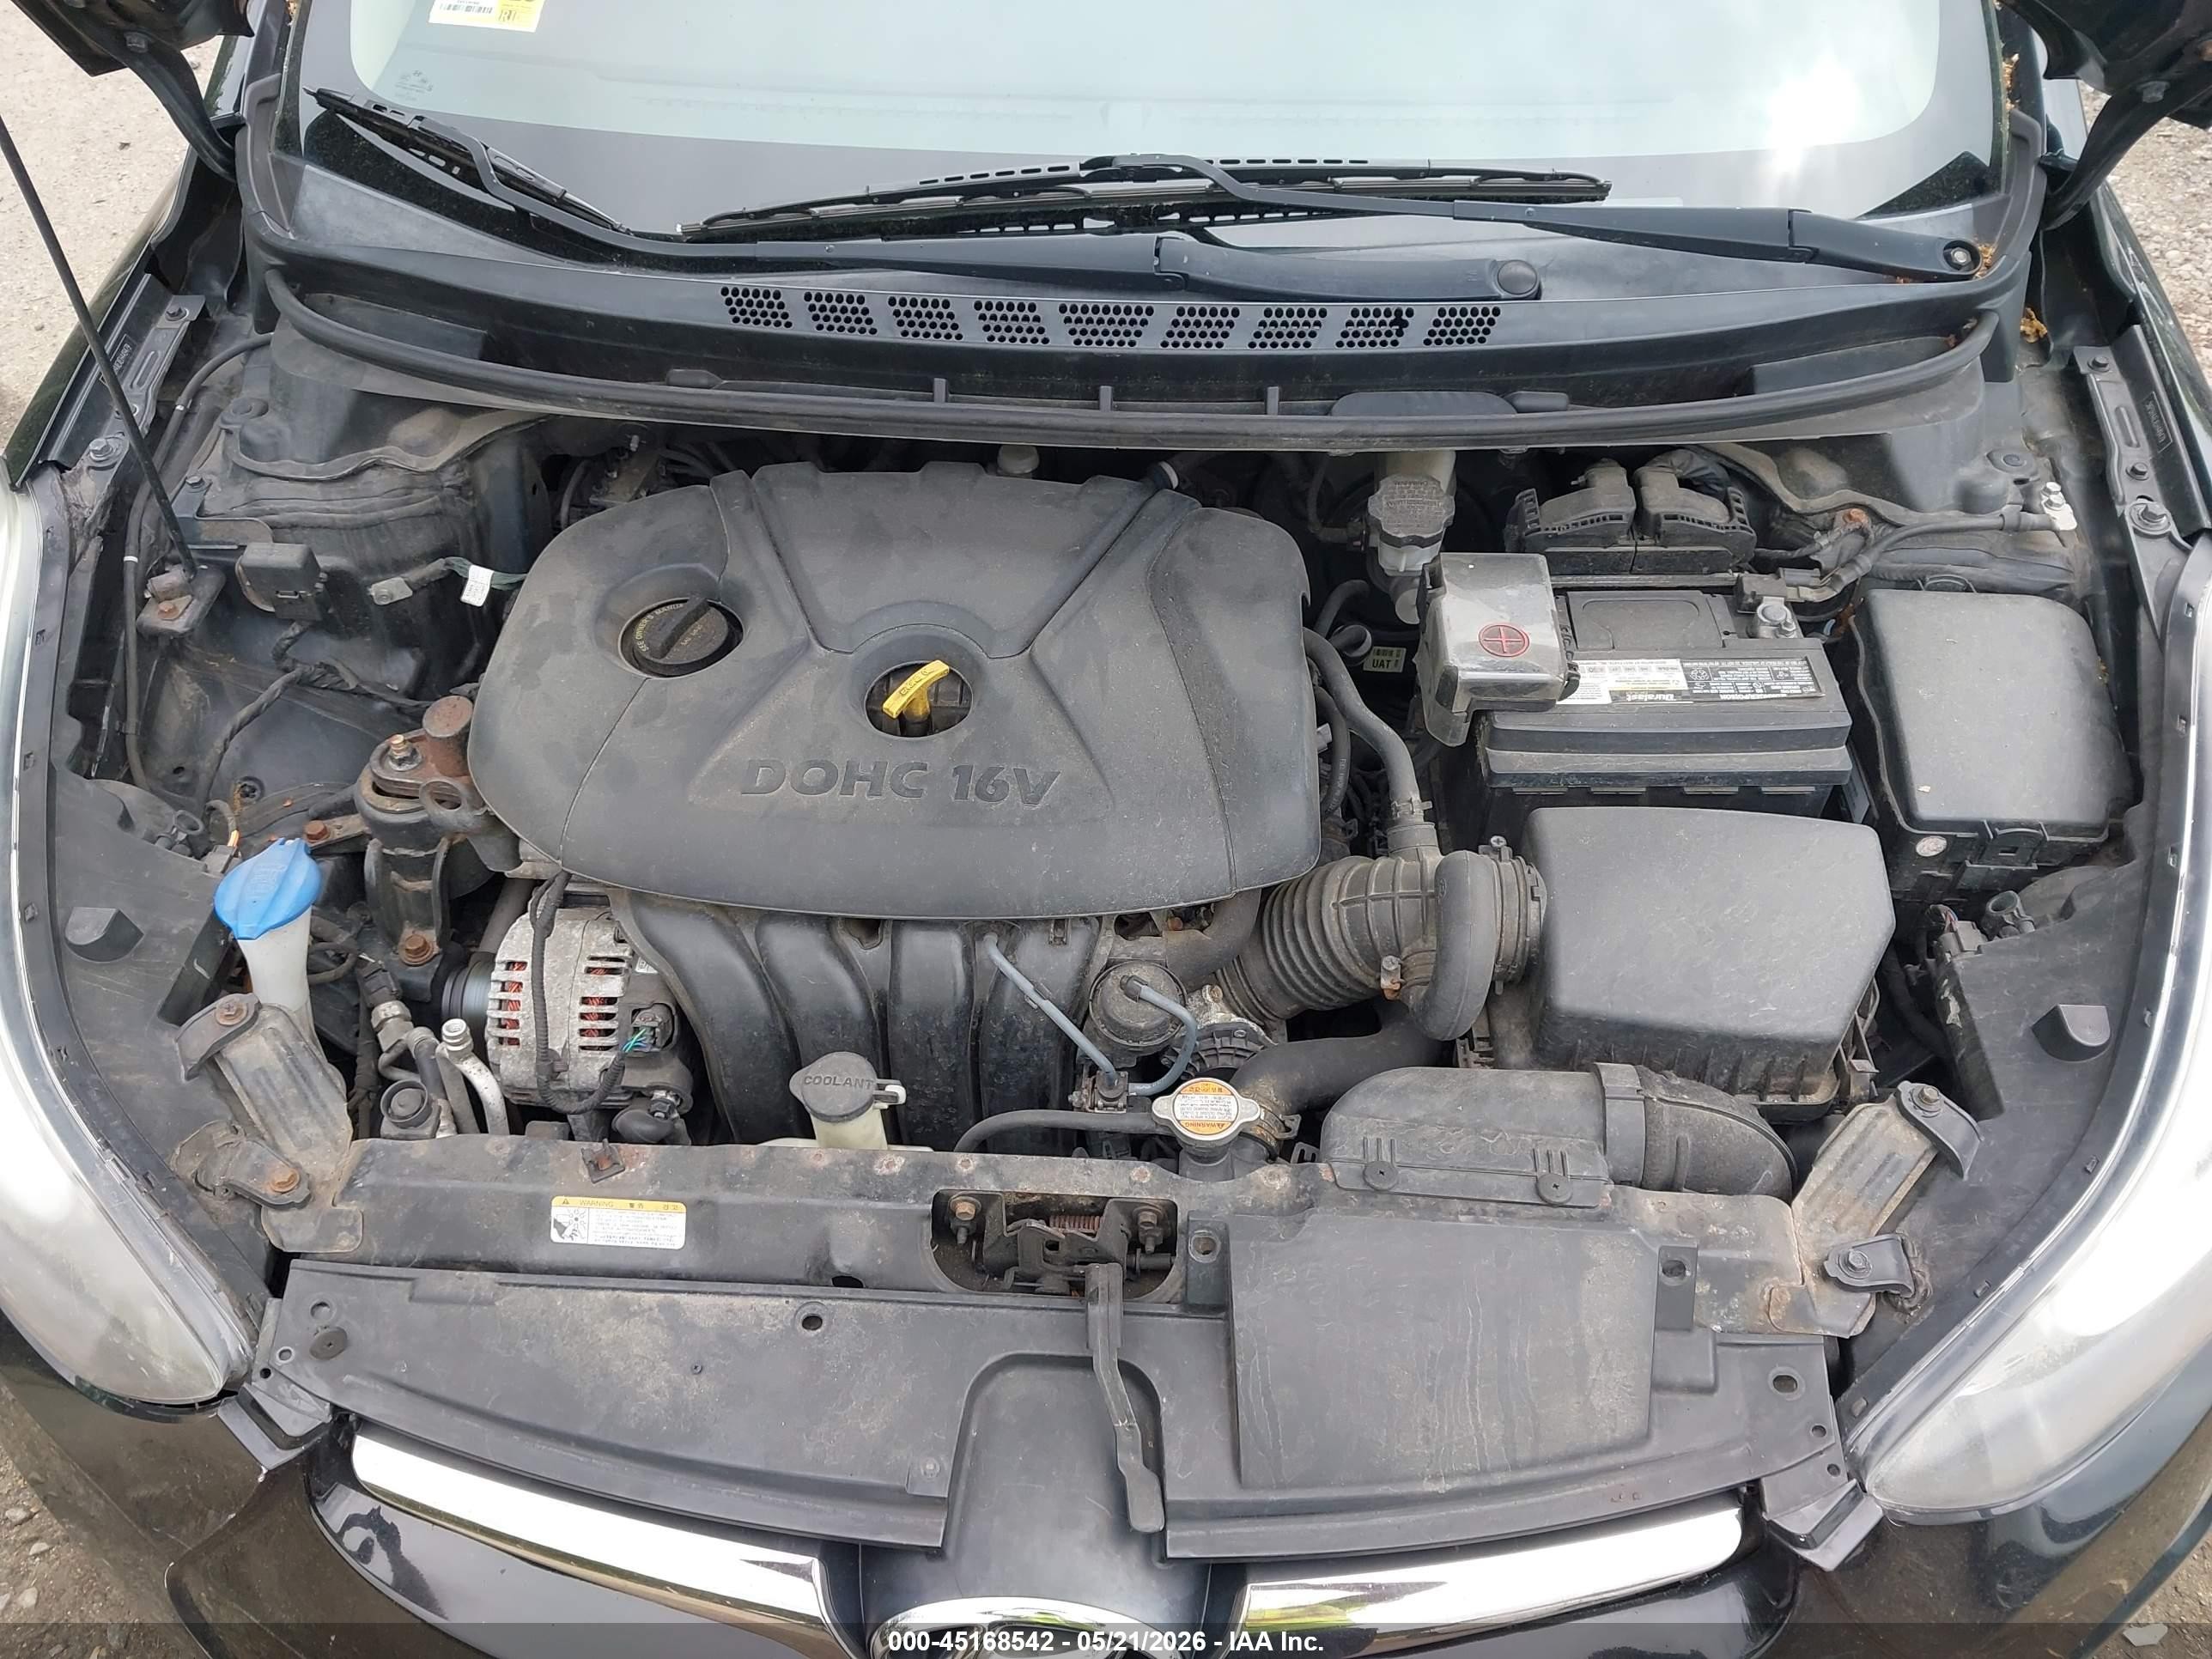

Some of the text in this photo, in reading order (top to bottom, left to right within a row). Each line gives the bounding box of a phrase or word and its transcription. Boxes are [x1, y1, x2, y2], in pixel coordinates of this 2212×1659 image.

[636, 640, 650, 653] SEE
[1372, 659, 1392, 669] UAT
[1626, 691, 1677, 702] Duralast
[741, 759, 1061, 805] DOHC 16V
[804, 1075, 874, 1090] COOLANT
[580, 1200, 614, 1208] WARNING
